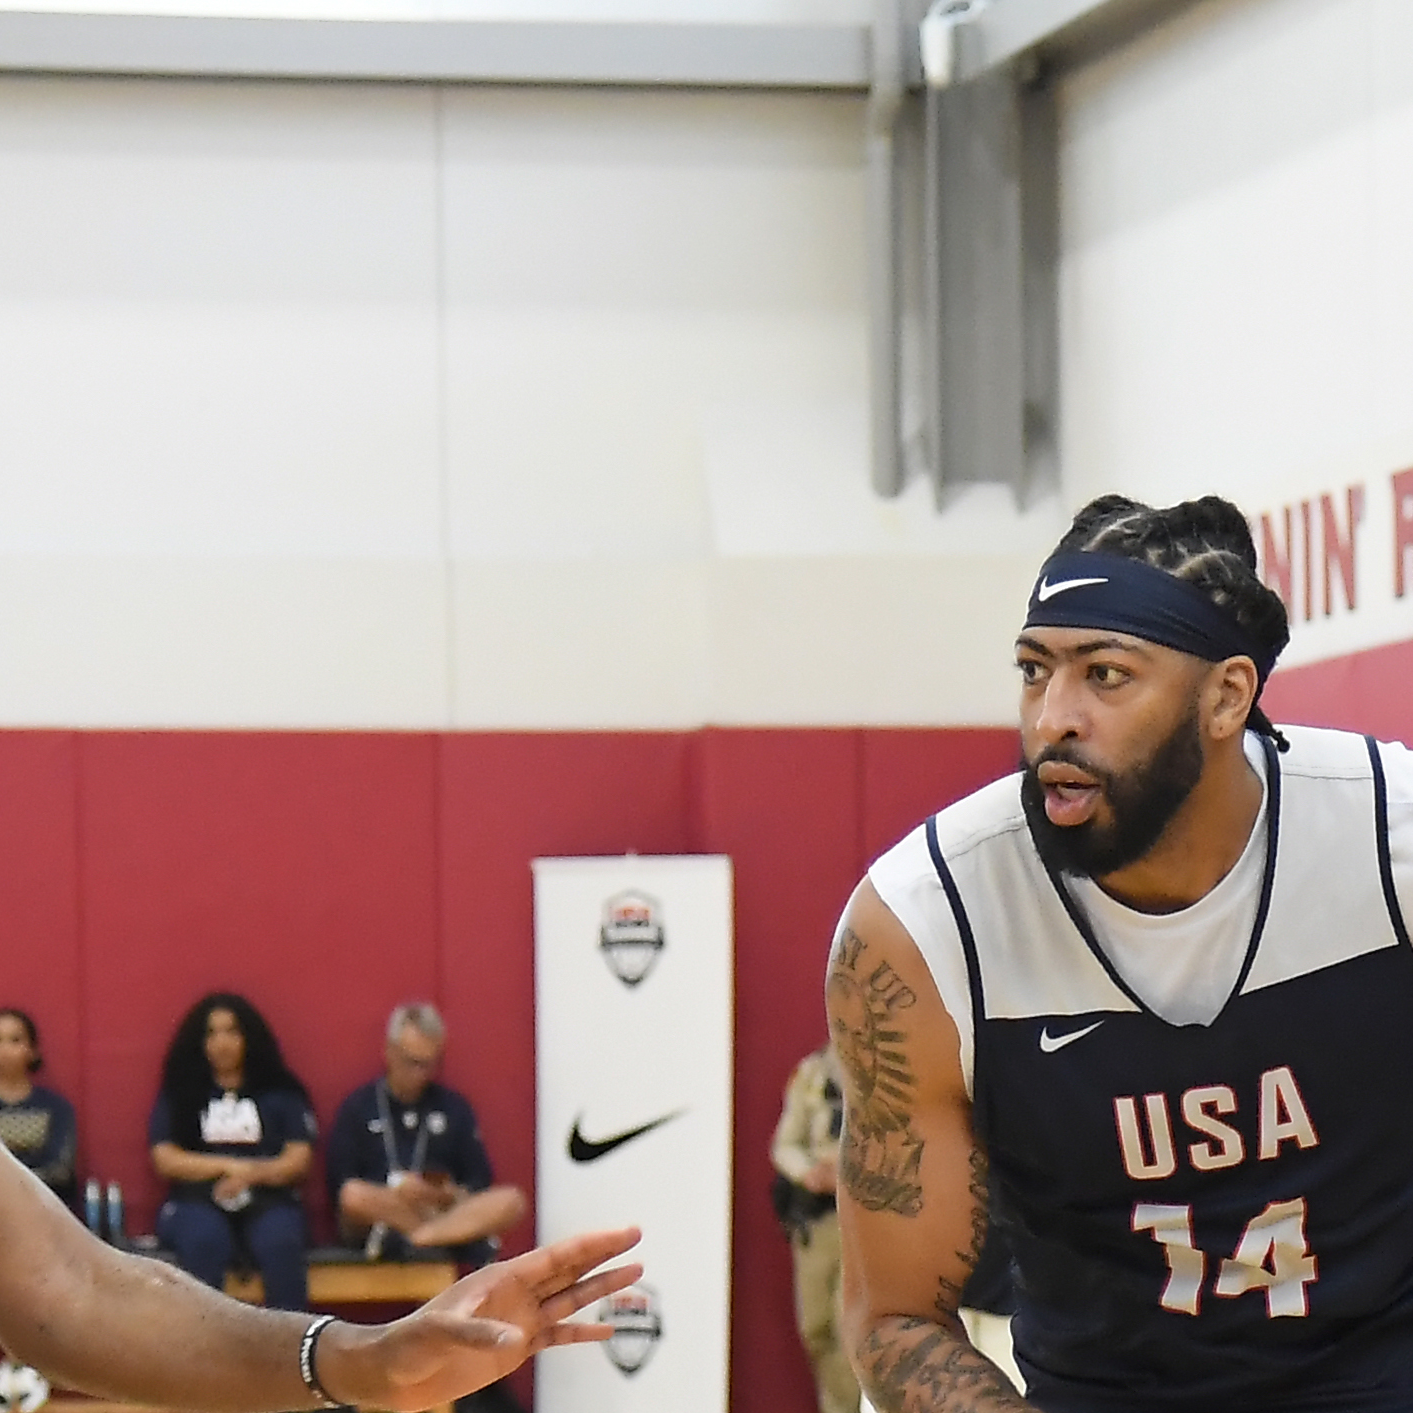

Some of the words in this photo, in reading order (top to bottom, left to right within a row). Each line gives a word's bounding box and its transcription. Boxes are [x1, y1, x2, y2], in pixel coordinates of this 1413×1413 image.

[1261, 478, 1365, 627] NIN'
[1113, 1064, 1320, 1180] USA
[1131, 1197, 1319, 1318] 14
